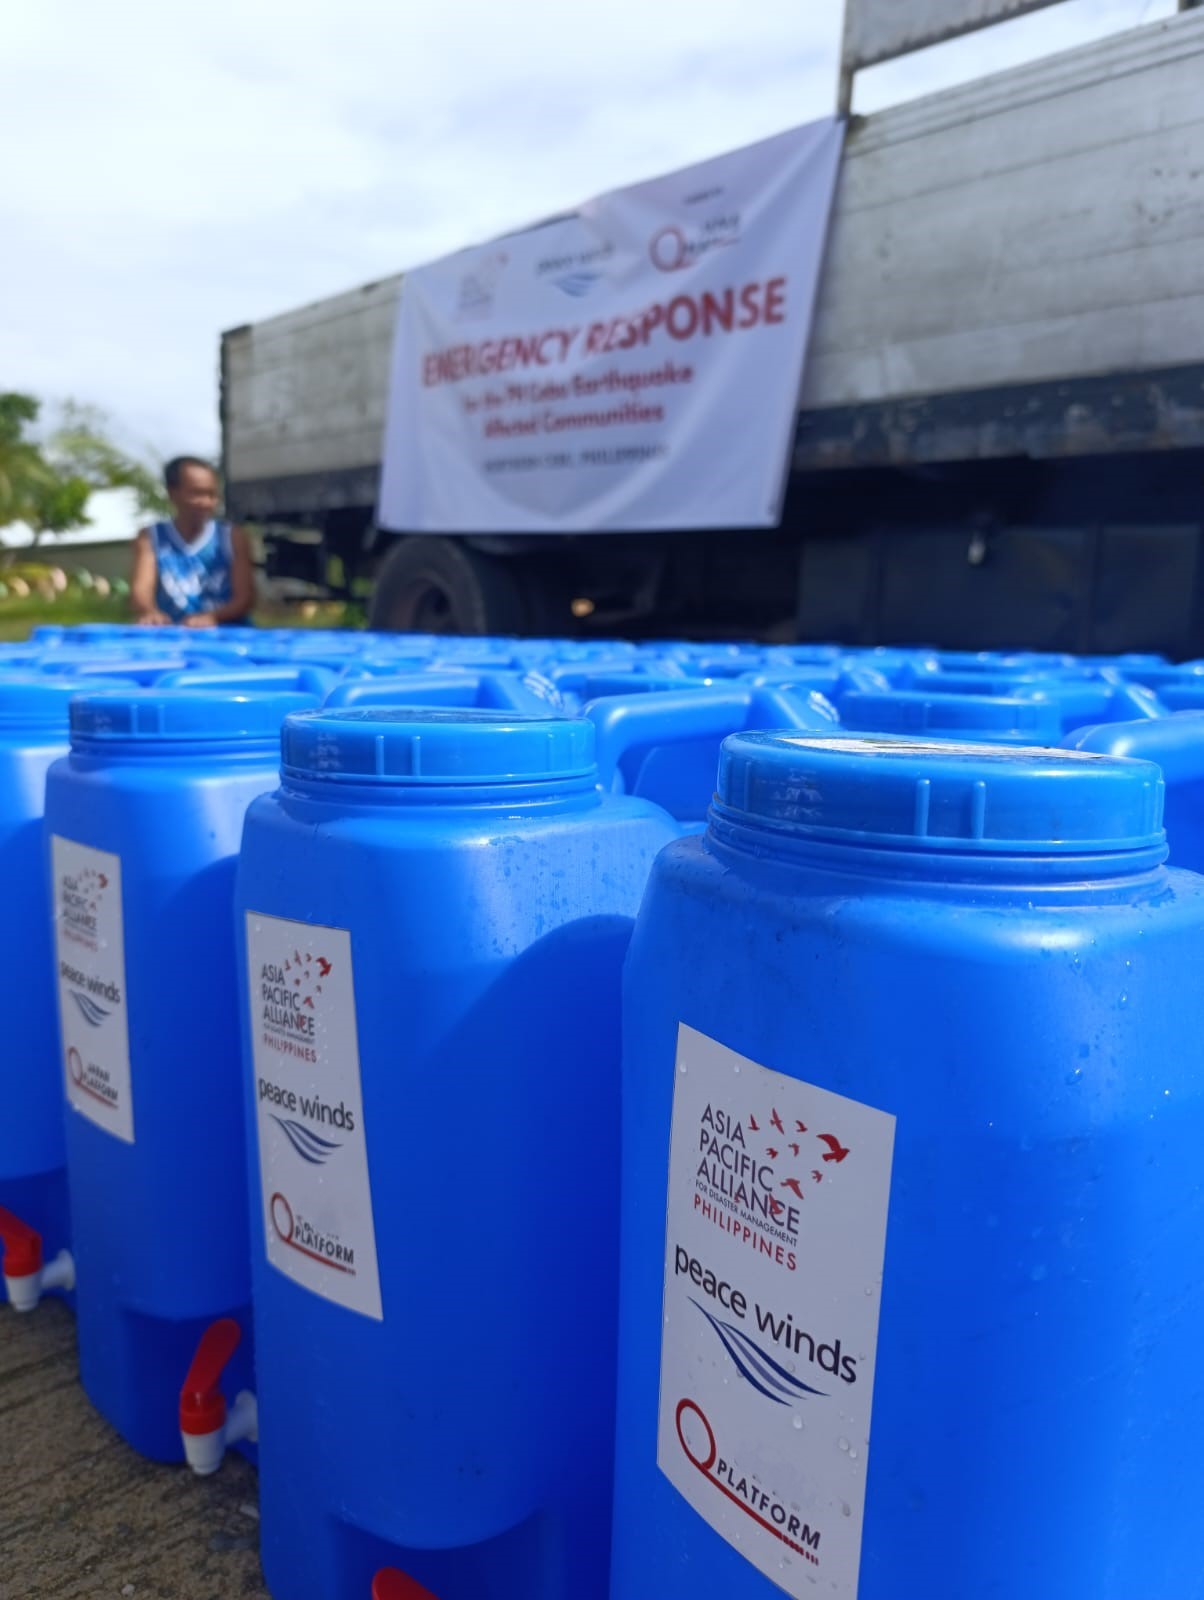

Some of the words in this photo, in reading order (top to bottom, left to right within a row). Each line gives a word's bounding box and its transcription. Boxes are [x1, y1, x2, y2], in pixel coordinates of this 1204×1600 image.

[583, 276, 788, 357] RESPONSE
[572, 361, 695, 398] Earthquake
[544, 402, 665, 433] Communities
[61, 960, 86, 988] peace
[87, 975, 121, 1004] winds
[261, 963, 286, 986] ASIA
[262, 983, 301, 1011] PACIFIC
[263, 1004, 315, 1036] ALLIANCE
[263, 1032, 318, 1064] PHILIPPINES
[258, 1077, 297, 1112] peace
[299, 1095, 355, 1131] winds
[700, 1103, 746, 1149] ASIA
[699, 1127, 775, 1193] PACIFIC
[695, 1178, 708, 1195] FOR
[708, 1188, 738, 1213] DISASTER
[740, 1209, 798, 1247] MANAGEMENT
[697, 1156, 801, 1235] ALLIANCE
[295, 1225, 354, 1264] PLATFORM
[693, 1192, 797, 1272] PHILIPPINES
[674, 1243, 748, 1320] peace
[755, 1302, 857, 1385] winds
[716, 1457, 822, 1551] PLATFORM
